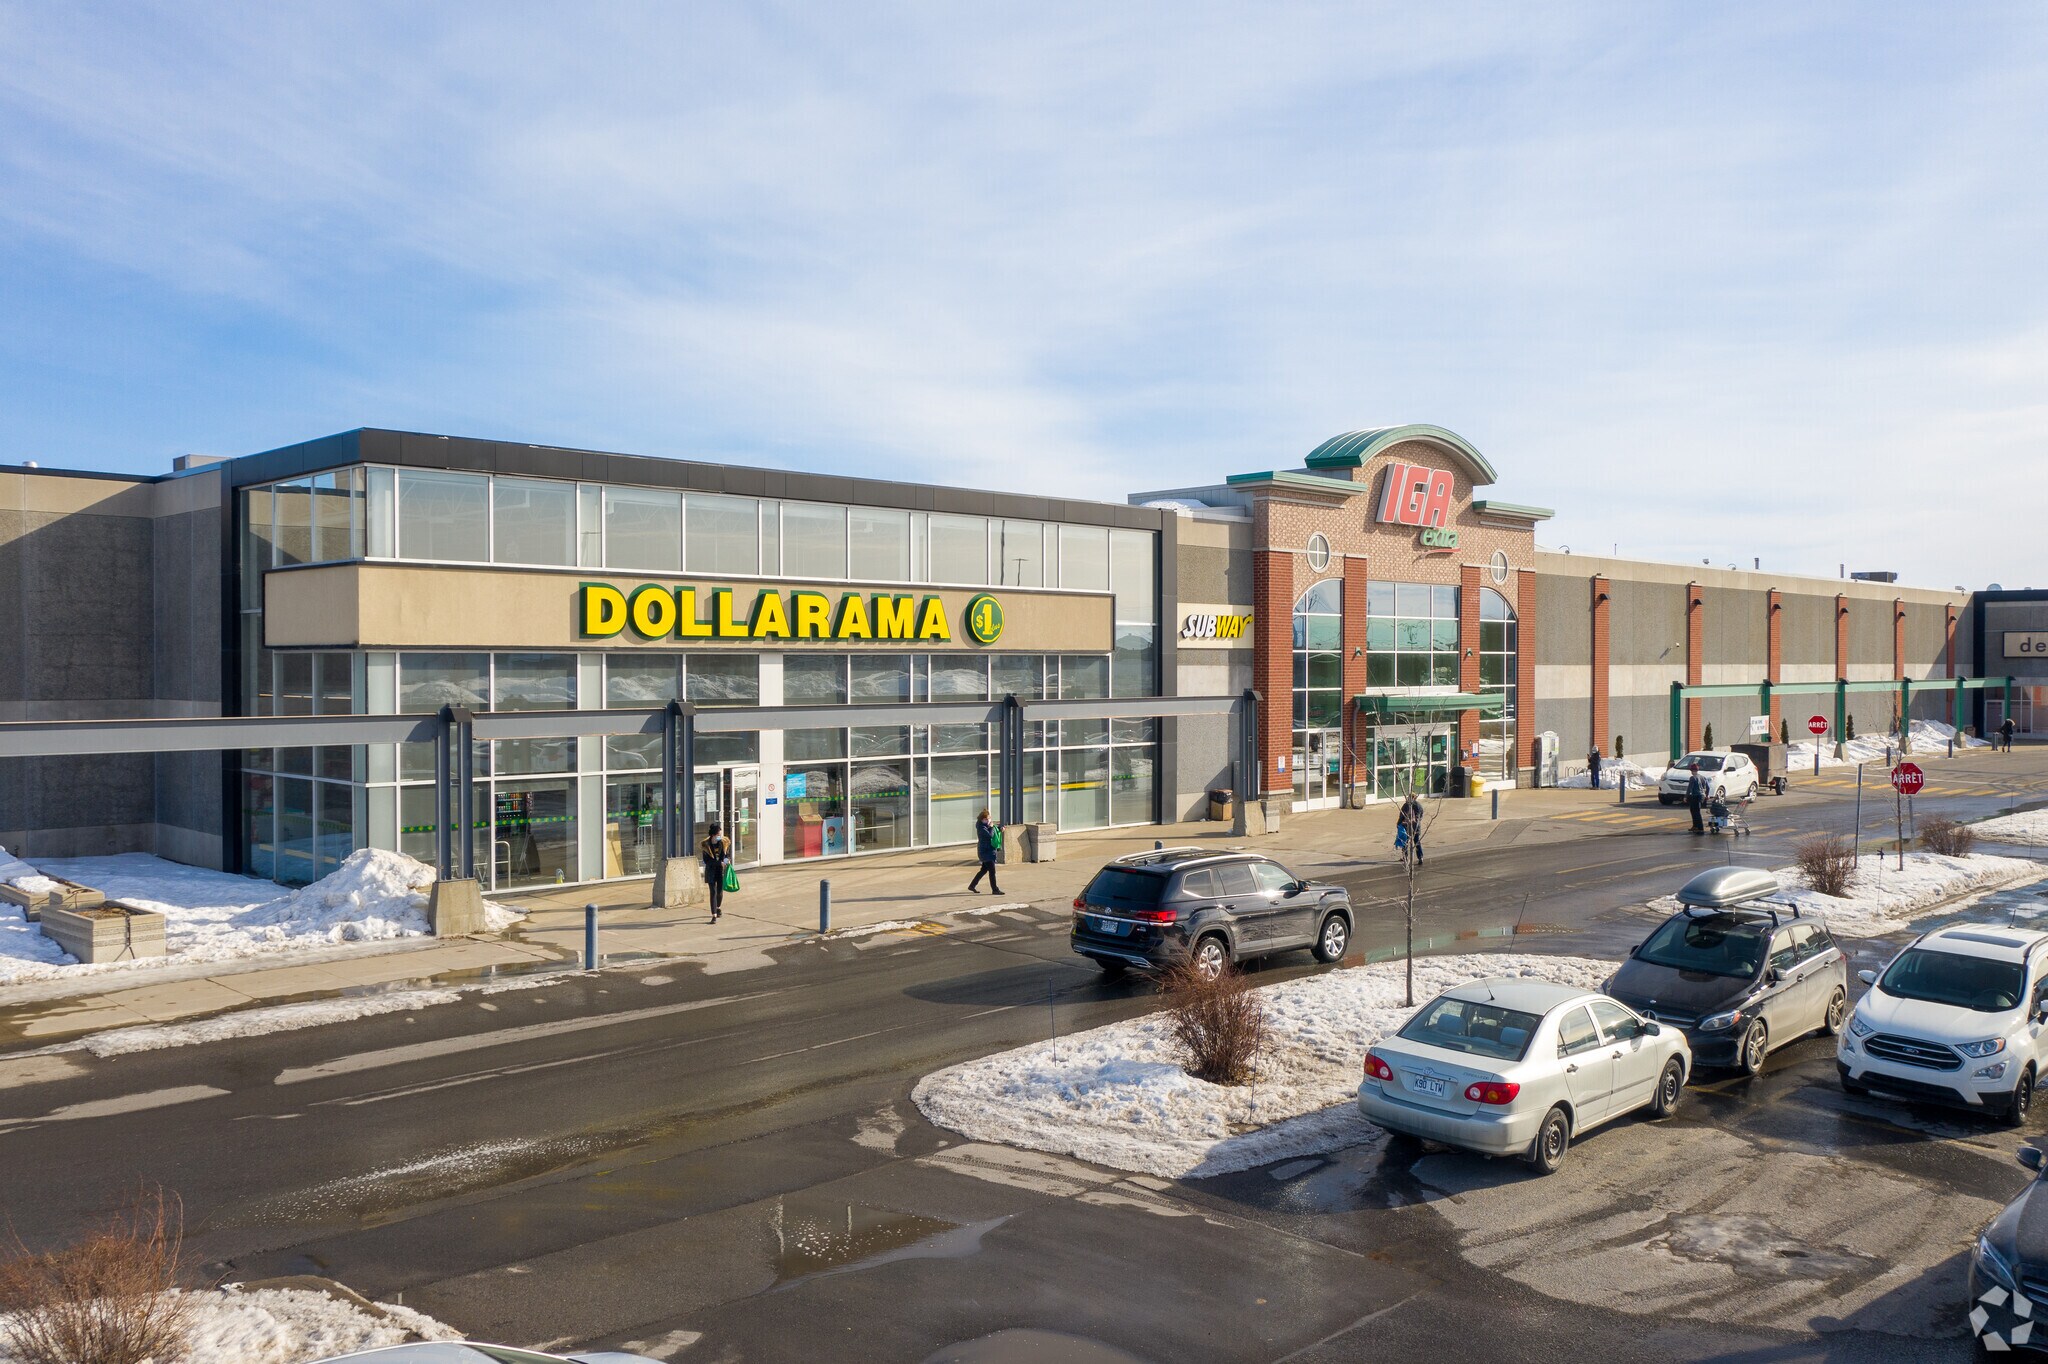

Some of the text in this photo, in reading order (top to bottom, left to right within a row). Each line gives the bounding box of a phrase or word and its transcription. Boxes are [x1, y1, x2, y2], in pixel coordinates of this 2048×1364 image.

[1380, 463, 1454, 528] IGA
[1422, 527, 1458, 548] extra
[580, 583, 951, 641] DOLLARAMA
[1182, 614, 1253, 638] SUBWAY
[1808, 720, 1827, 729] ARRÊT
[1892, 772, 1922, 784] ARRÊT
